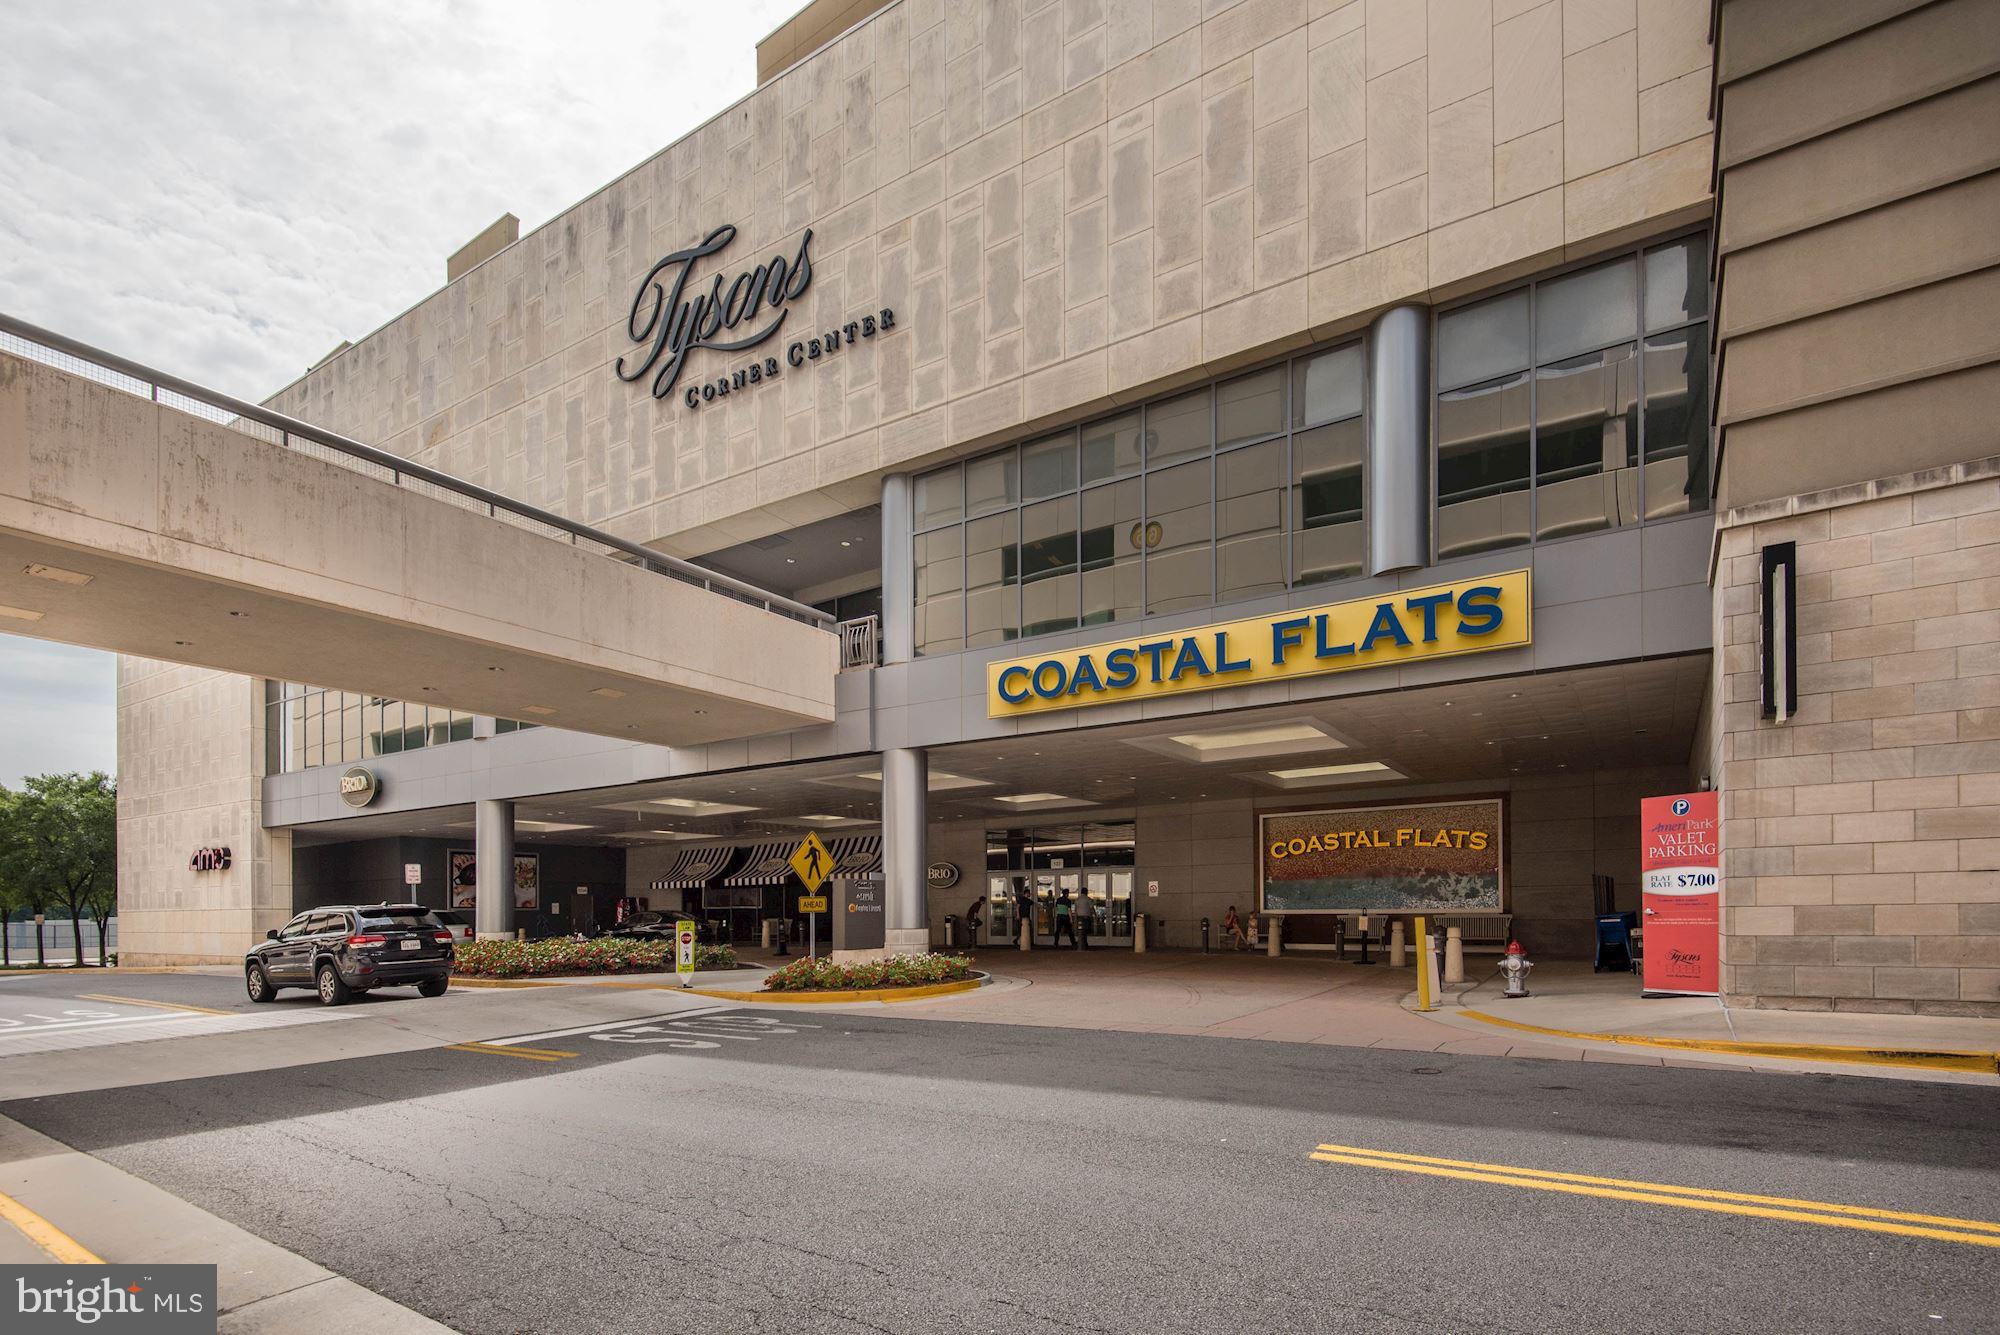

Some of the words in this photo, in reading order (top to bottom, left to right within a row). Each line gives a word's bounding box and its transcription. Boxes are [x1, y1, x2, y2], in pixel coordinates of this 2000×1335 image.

[616, 224, 813, 399] Tysons
[685, 356, 779, 409] CORNER
[787, 307, 896, 367] CENTER
[998, 631, 1252, 703] COASTAL
[1271, 587, 1503, 664] FLATS
[341, 776, 368, 794] BRIO
[1270, 830, 1390, 859] COASTAL
[1396, 829, 1488, 850] FLATS
[1658, 832, 1705, 845] VALET
[1649, 843, 1716, 858] PARKING
[928, 867, 951, 880] BRIO
[1678, 874, 1715, 888] $7.00
[803, 901, 823, 909] AHEAD
[1666, 949, 1701, 964] Tysons
